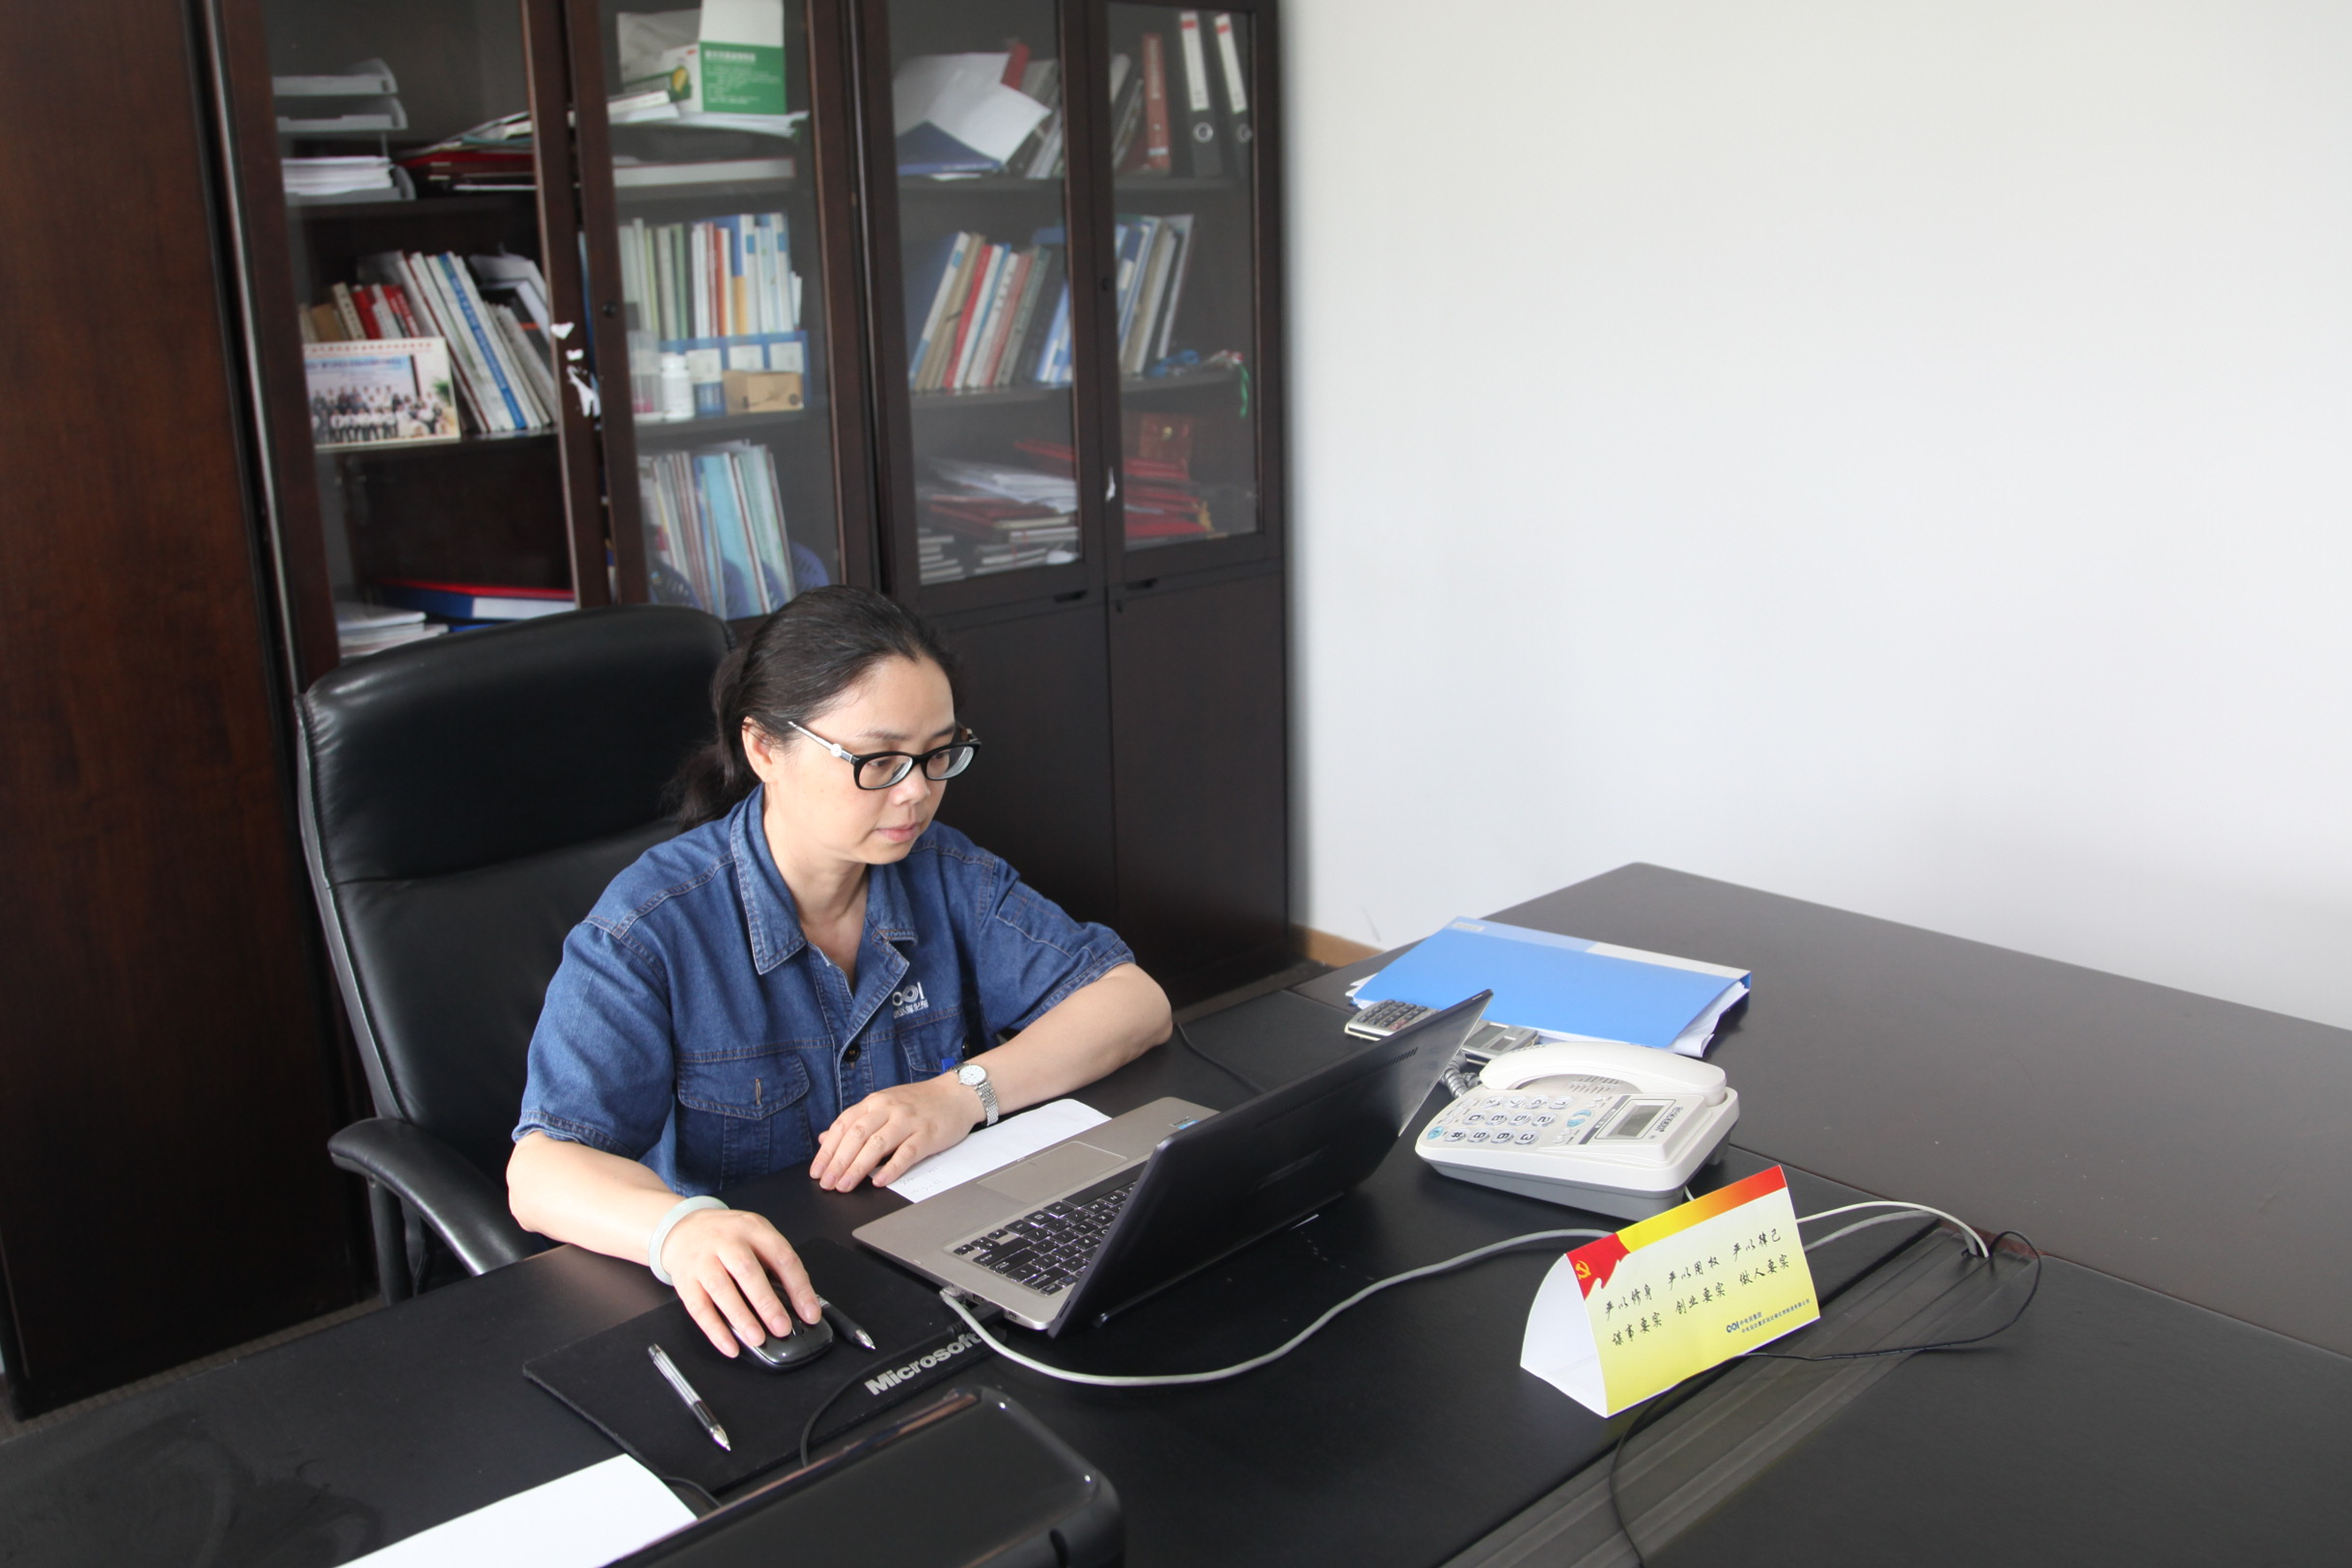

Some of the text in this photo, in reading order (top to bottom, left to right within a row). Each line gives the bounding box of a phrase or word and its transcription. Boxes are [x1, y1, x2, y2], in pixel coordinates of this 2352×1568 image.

[1606, 1228, 1781, 1321] 严以修身 严以用权 严以律己
[1612, 1254, 1789, 1345] 谋事要实 创业要实 做人要实
[865, 1333, 982, 1396] Microsoft
